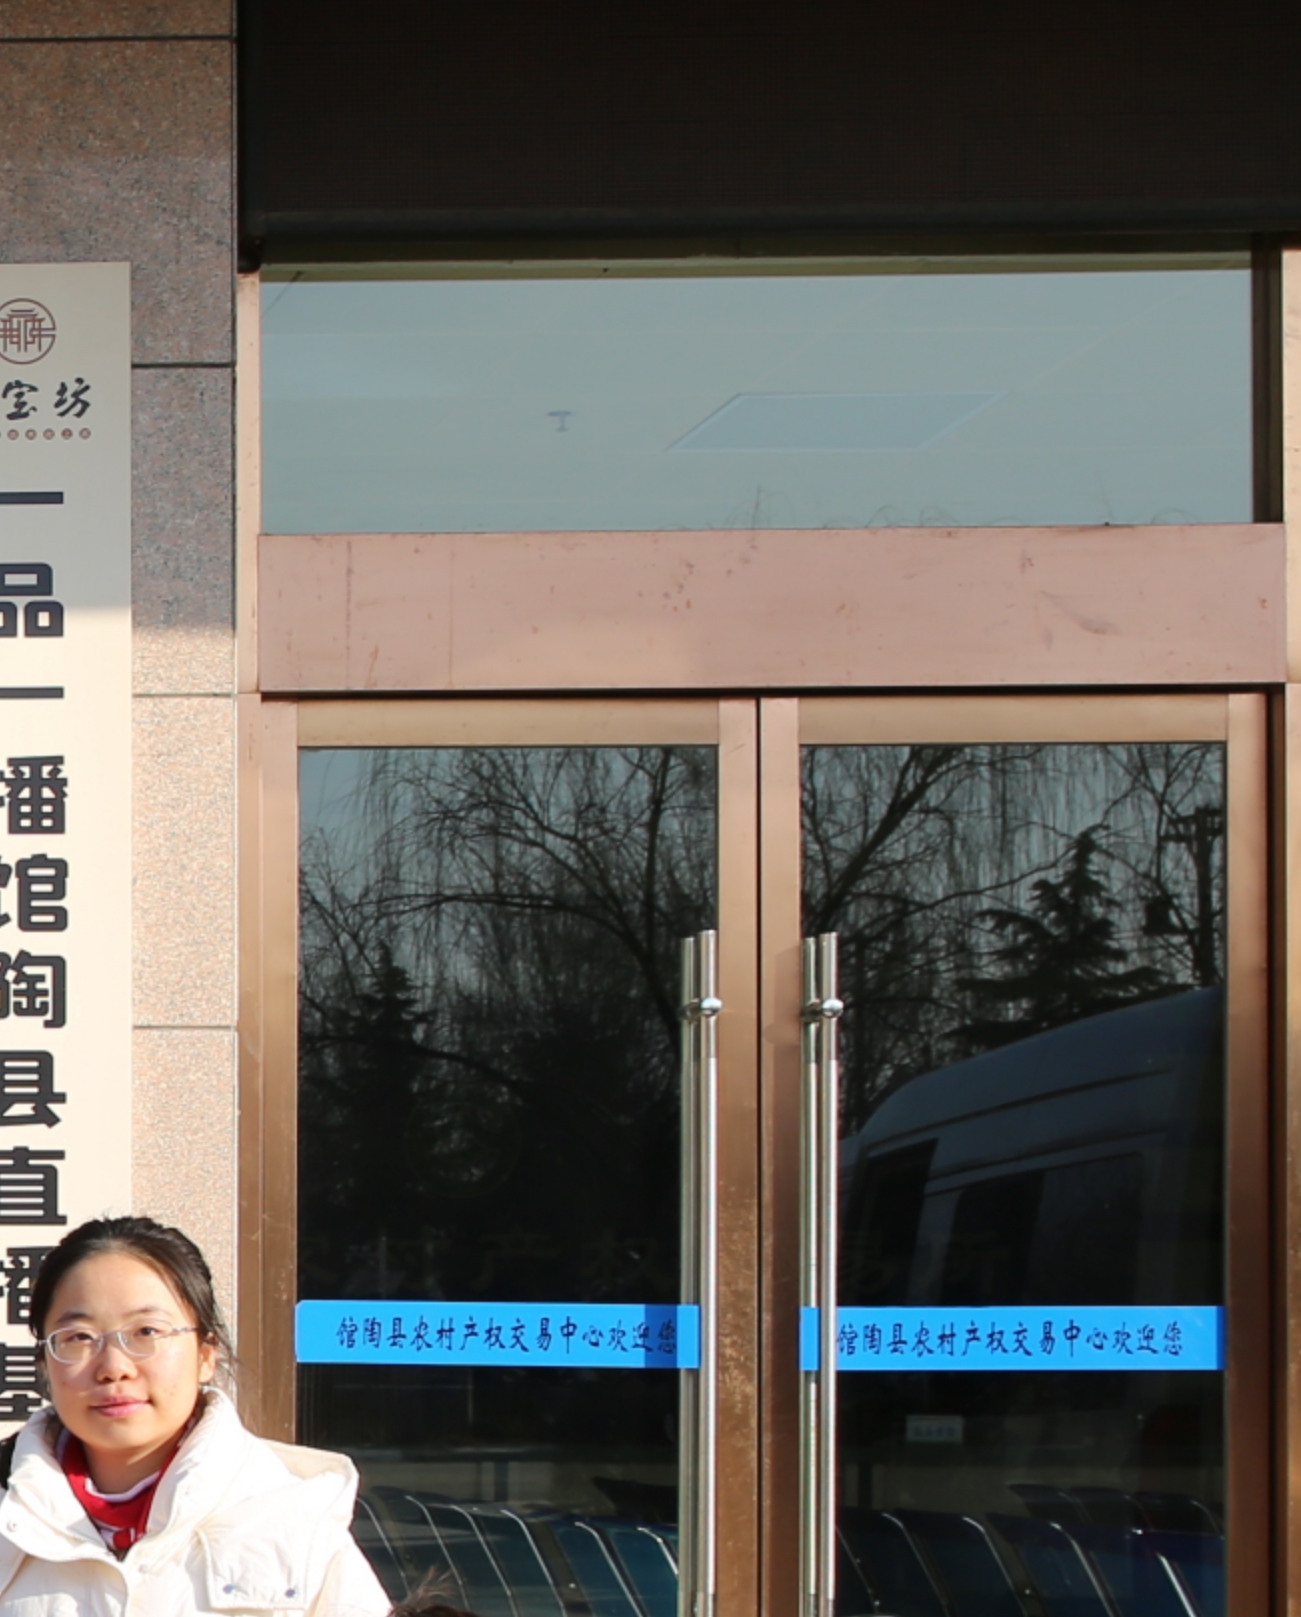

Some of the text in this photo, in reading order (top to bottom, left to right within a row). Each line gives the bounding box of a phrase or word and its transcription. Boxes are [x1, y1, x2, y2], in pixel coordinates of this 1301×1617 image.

[335, 1316, 678, 1355] 馆陶县农村产权交易中心欢迎您
[836, 1319, 1184, 1358] 馆陶县农村产权交易中心欢迎您
